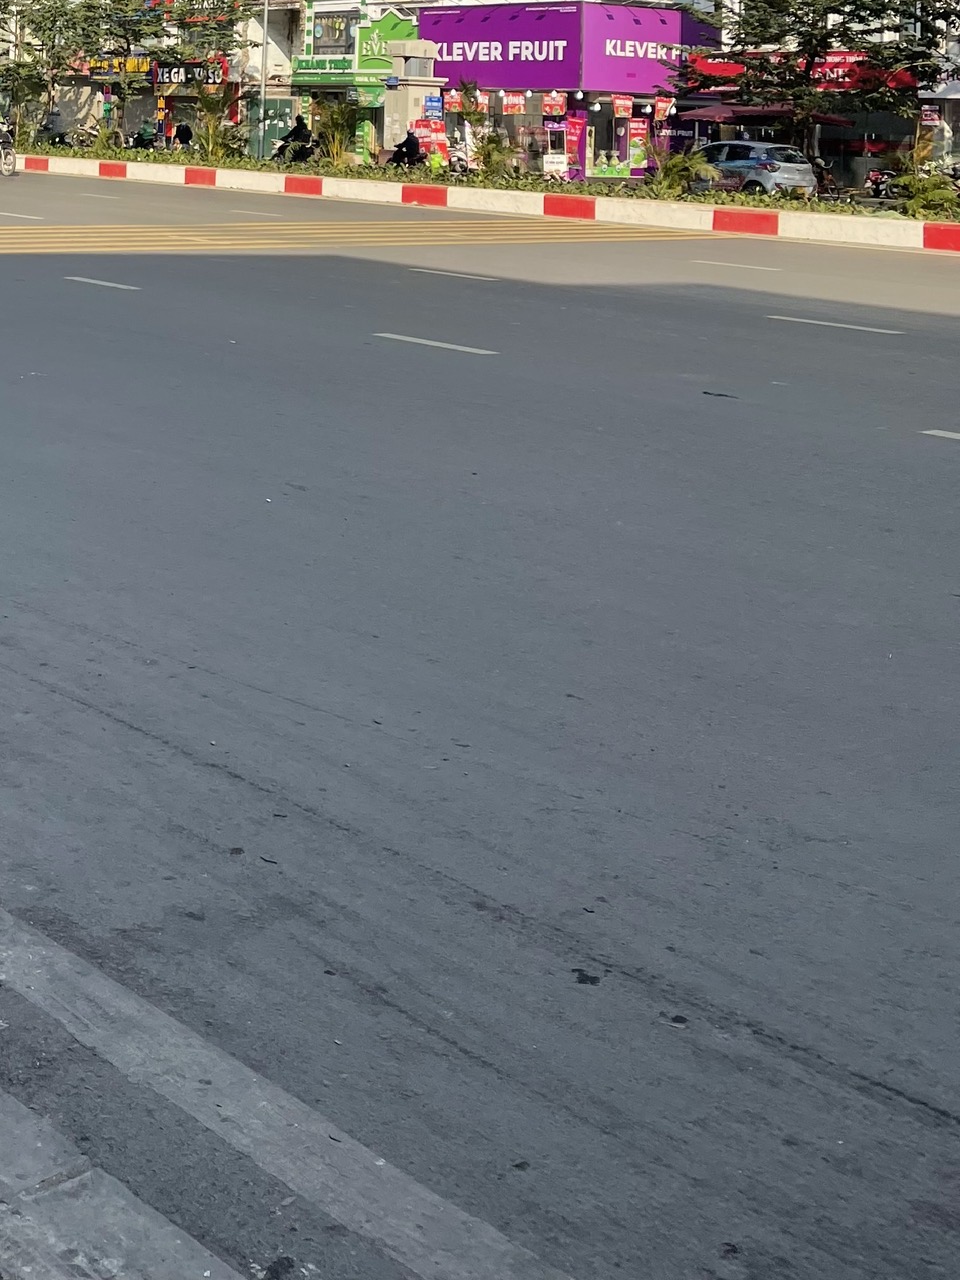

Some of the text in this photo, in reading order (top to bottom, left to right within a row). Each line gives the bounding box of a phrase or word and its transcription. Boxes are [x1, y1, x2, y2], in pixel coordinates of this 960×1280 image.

[508, 40, 567, 61] FRUIT
[605, 39, 668, 59] KLEVER
[157, 67, 169, 82] XE
[170, 67, 186, 82] GA
